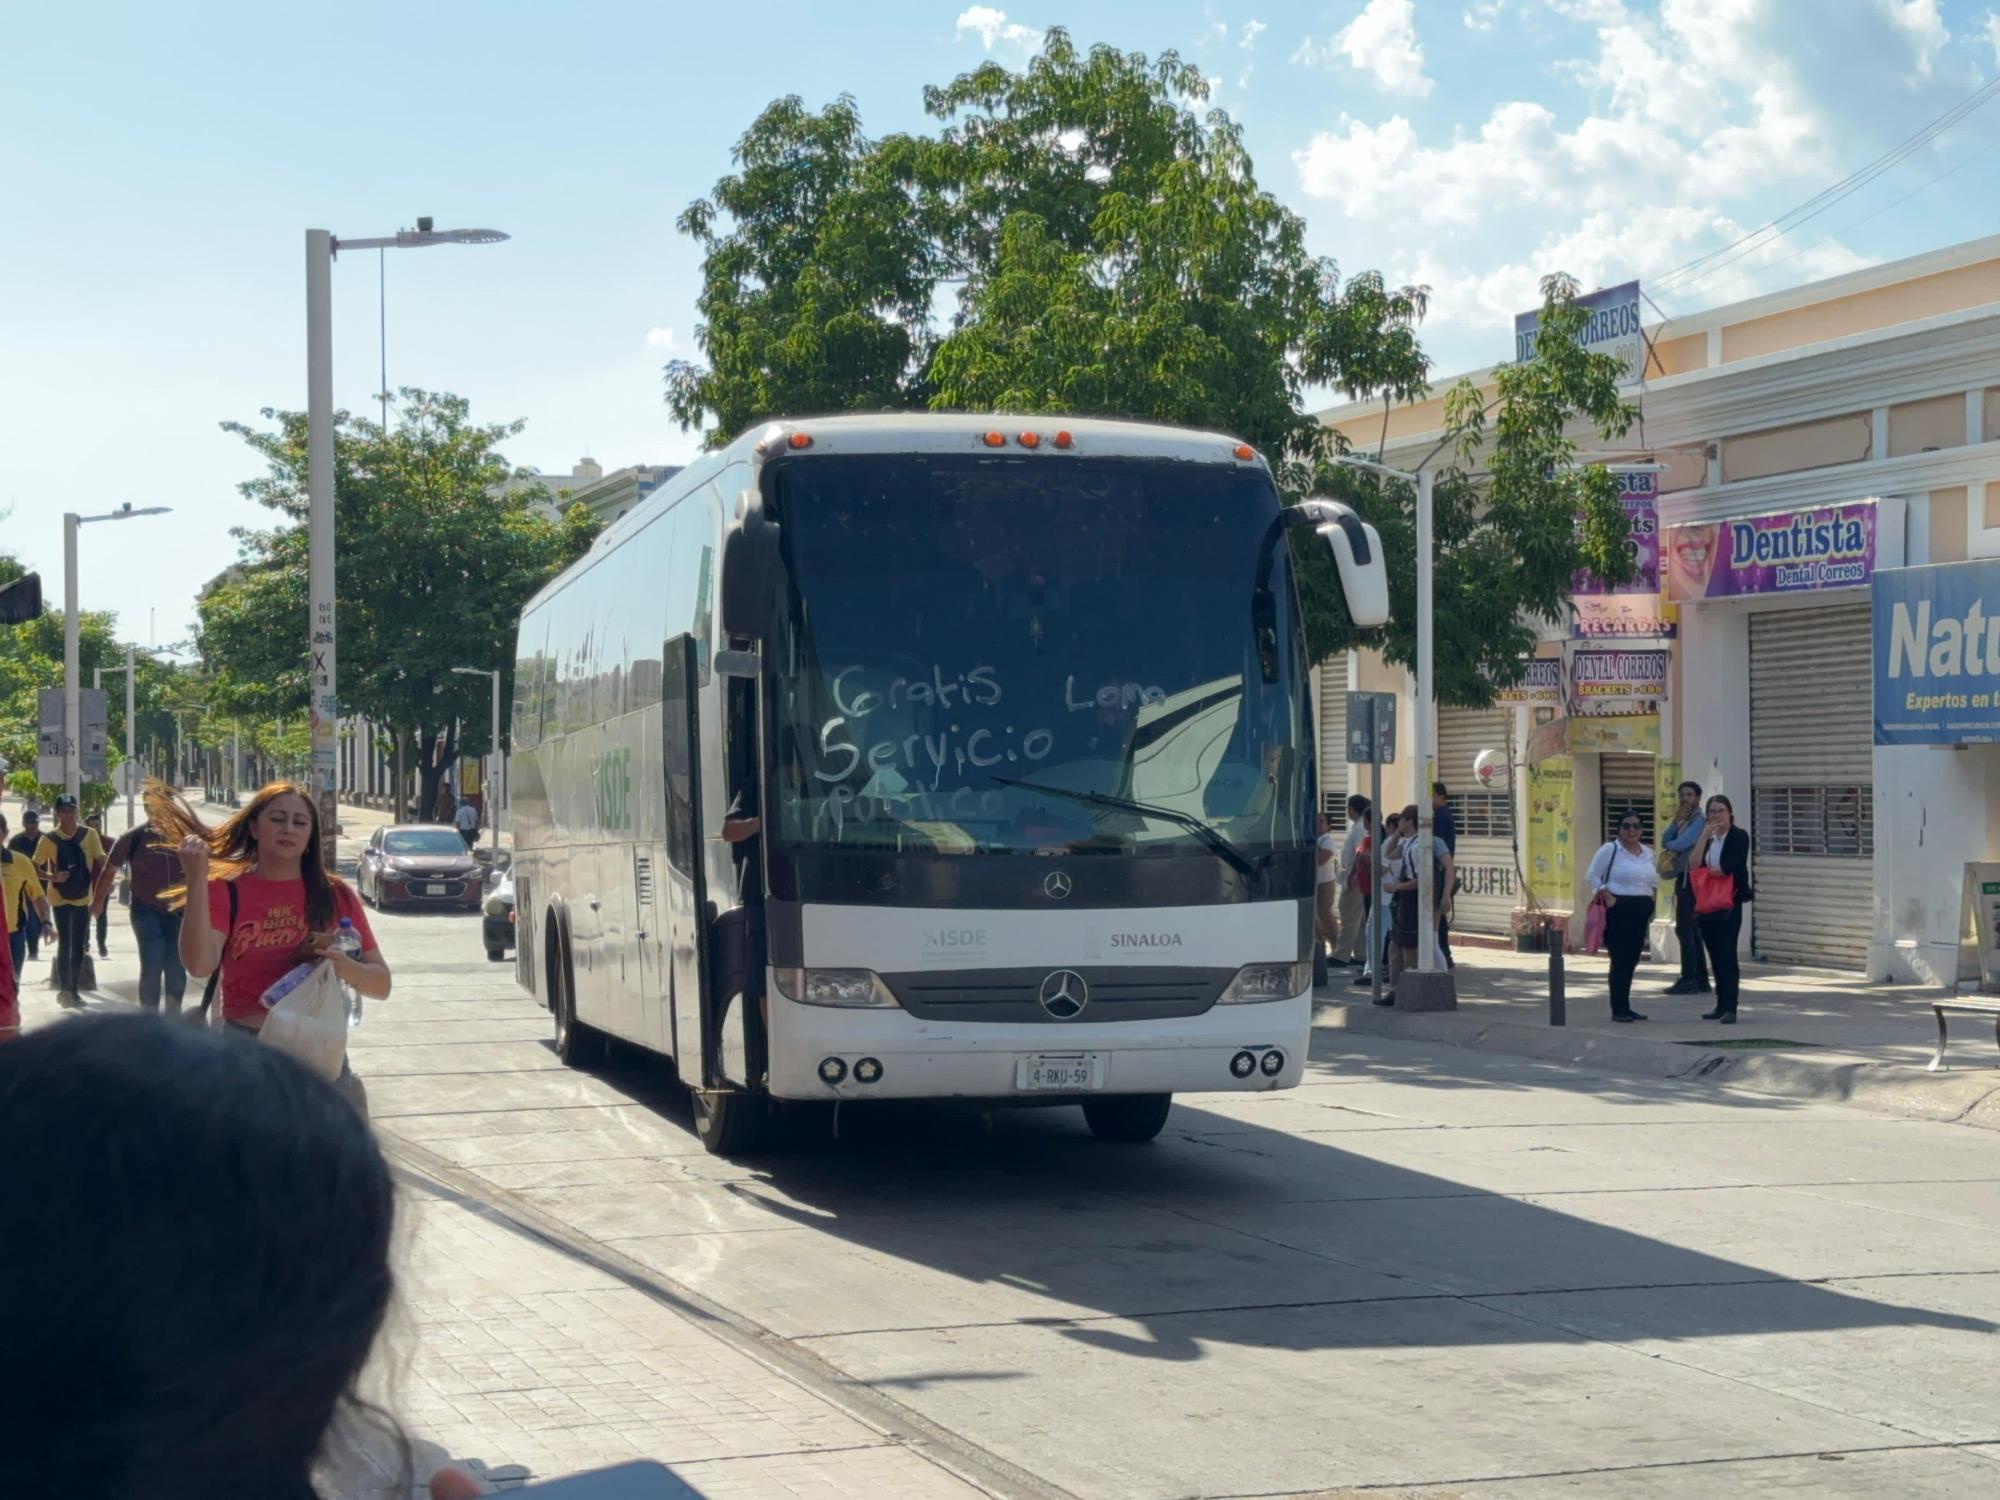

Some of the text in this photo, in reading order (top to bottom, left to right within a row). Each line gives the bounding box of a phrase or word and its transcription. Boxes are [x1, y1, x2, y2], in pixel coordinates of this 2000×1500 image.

[1573, 302, 1639, 346] ORREOS
[1733, 513, 1865, 564] Dentista
[1778, 563, 1863, 585] Dental Correos
[1581, 617, 1671, 632] RECARGAS
[1577, 655, 1664, 681] DENTAL CORREOS
[832, 664, 1000, 717] Gratis
[1905, 692, 1967, 712] Expertos
[1971, 695, 1991, 708] en
[1455, 866, 1515, 895] FUJIFIL
[941, 929, 987, 946] ISDE
[1110, 933, 1182, 947] SINALOA
